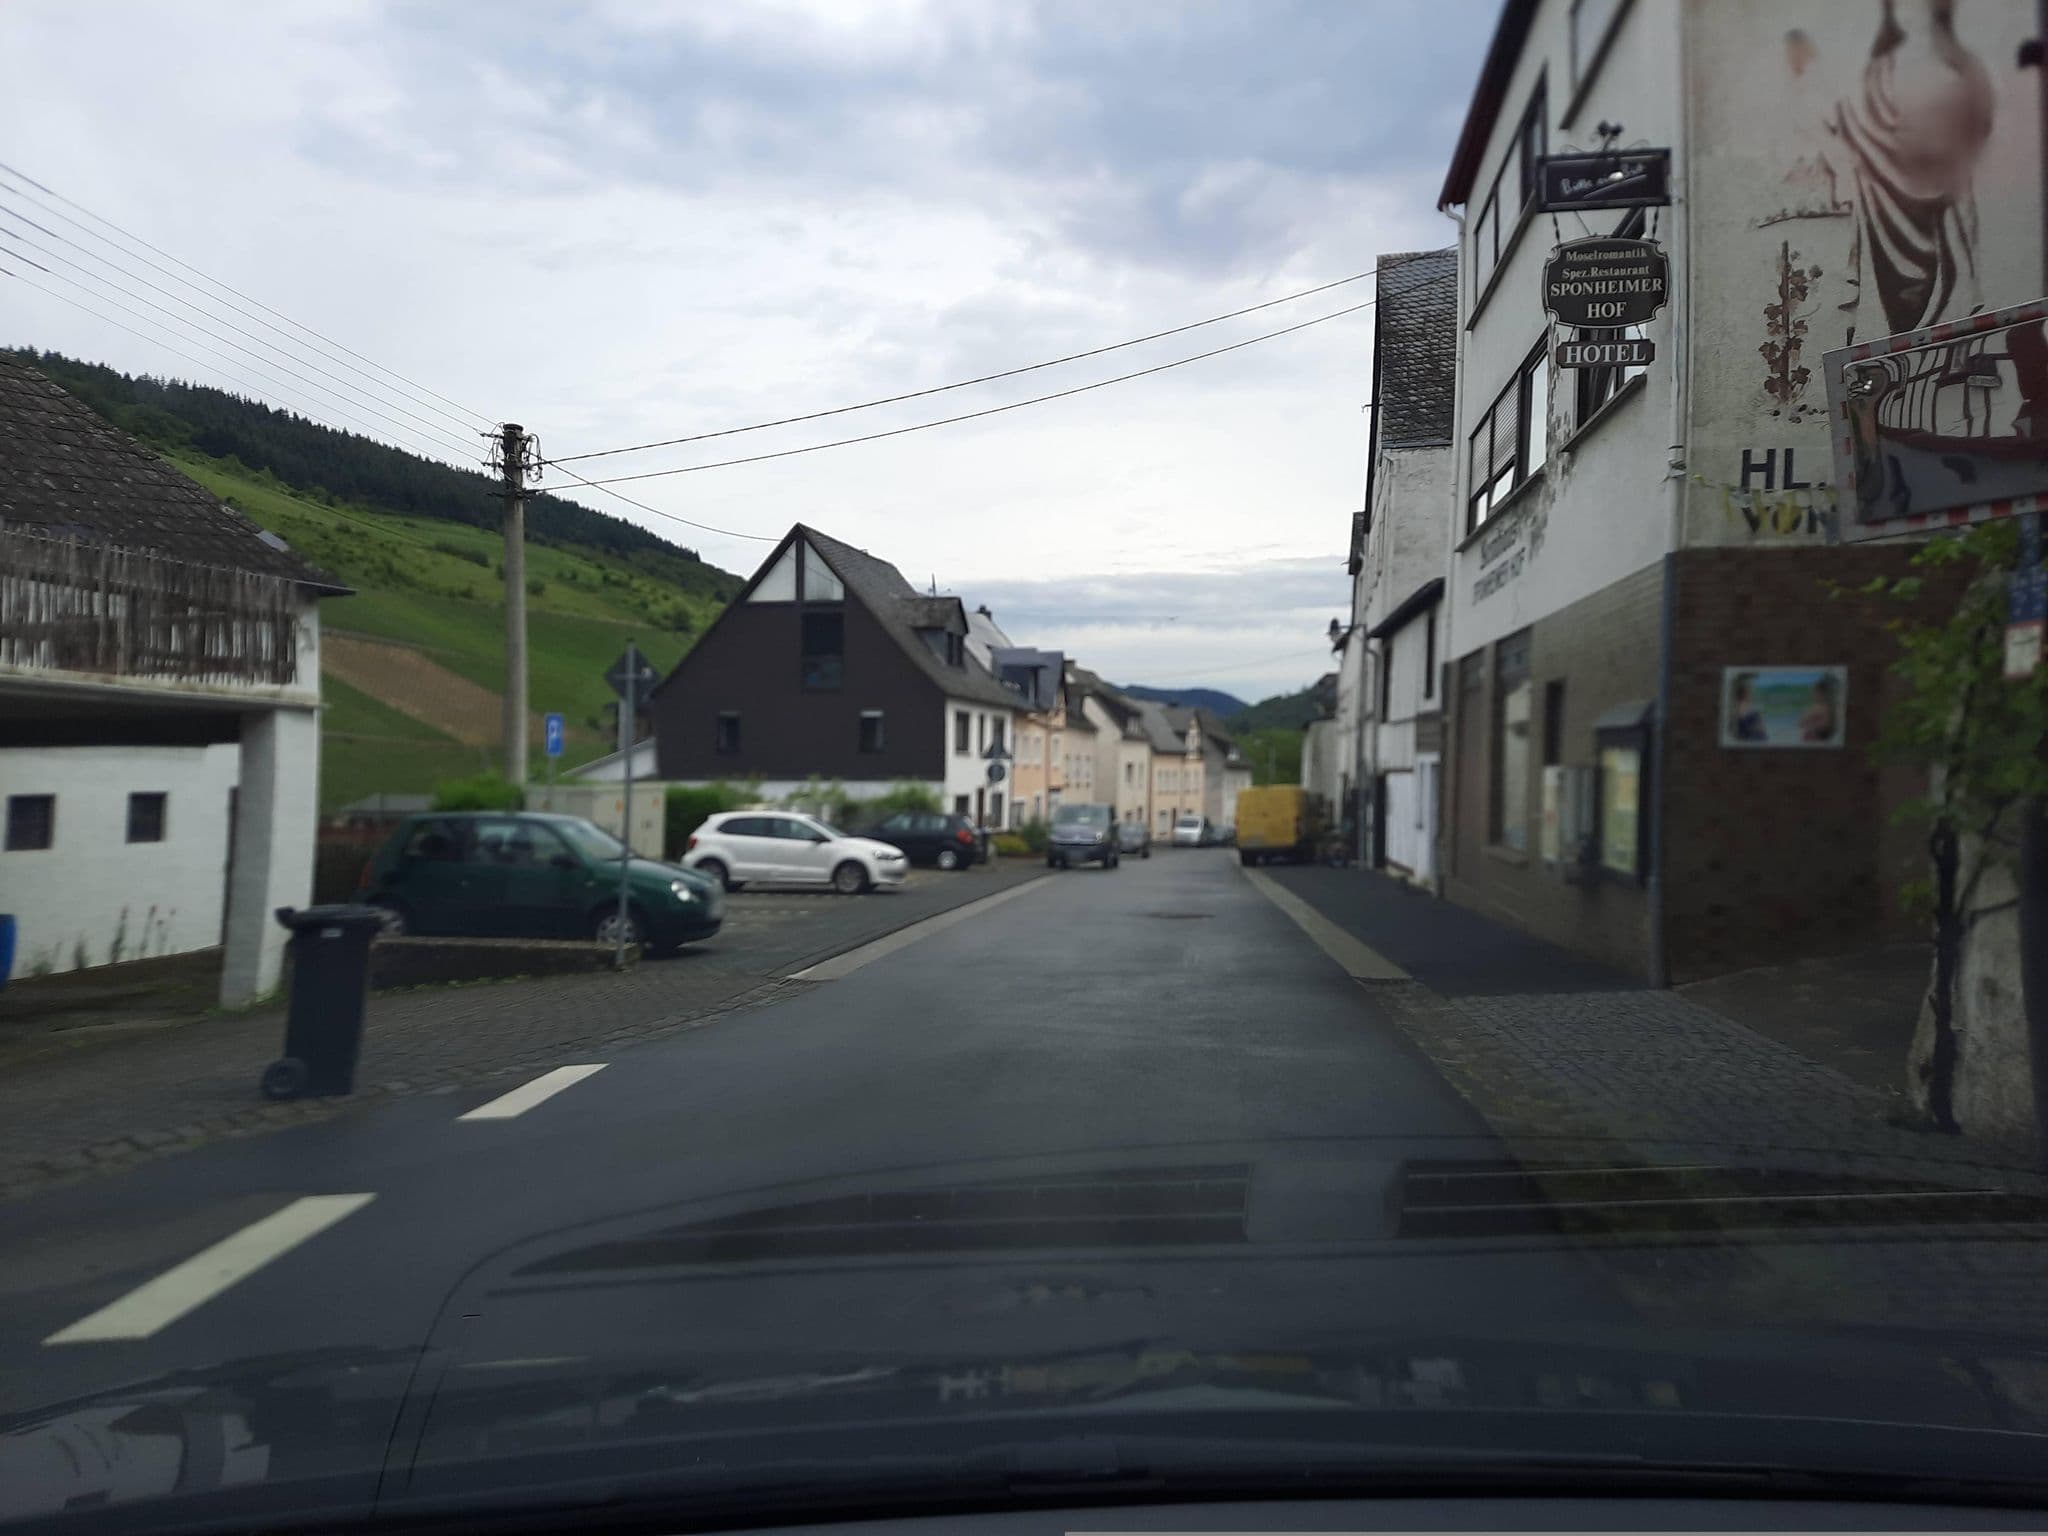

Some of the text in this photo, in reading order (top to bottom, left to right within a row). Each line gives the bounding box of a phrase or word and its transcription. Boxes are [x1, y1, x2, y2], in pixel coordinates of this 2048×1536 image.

[1566, 247, 1648, 261] Moselromantik
[1550, 278, 1663, 297] SPONHEIMER
[1586, 301, 1628, 319] HOF
[1565, 343, 1647, 364] HOTEL
